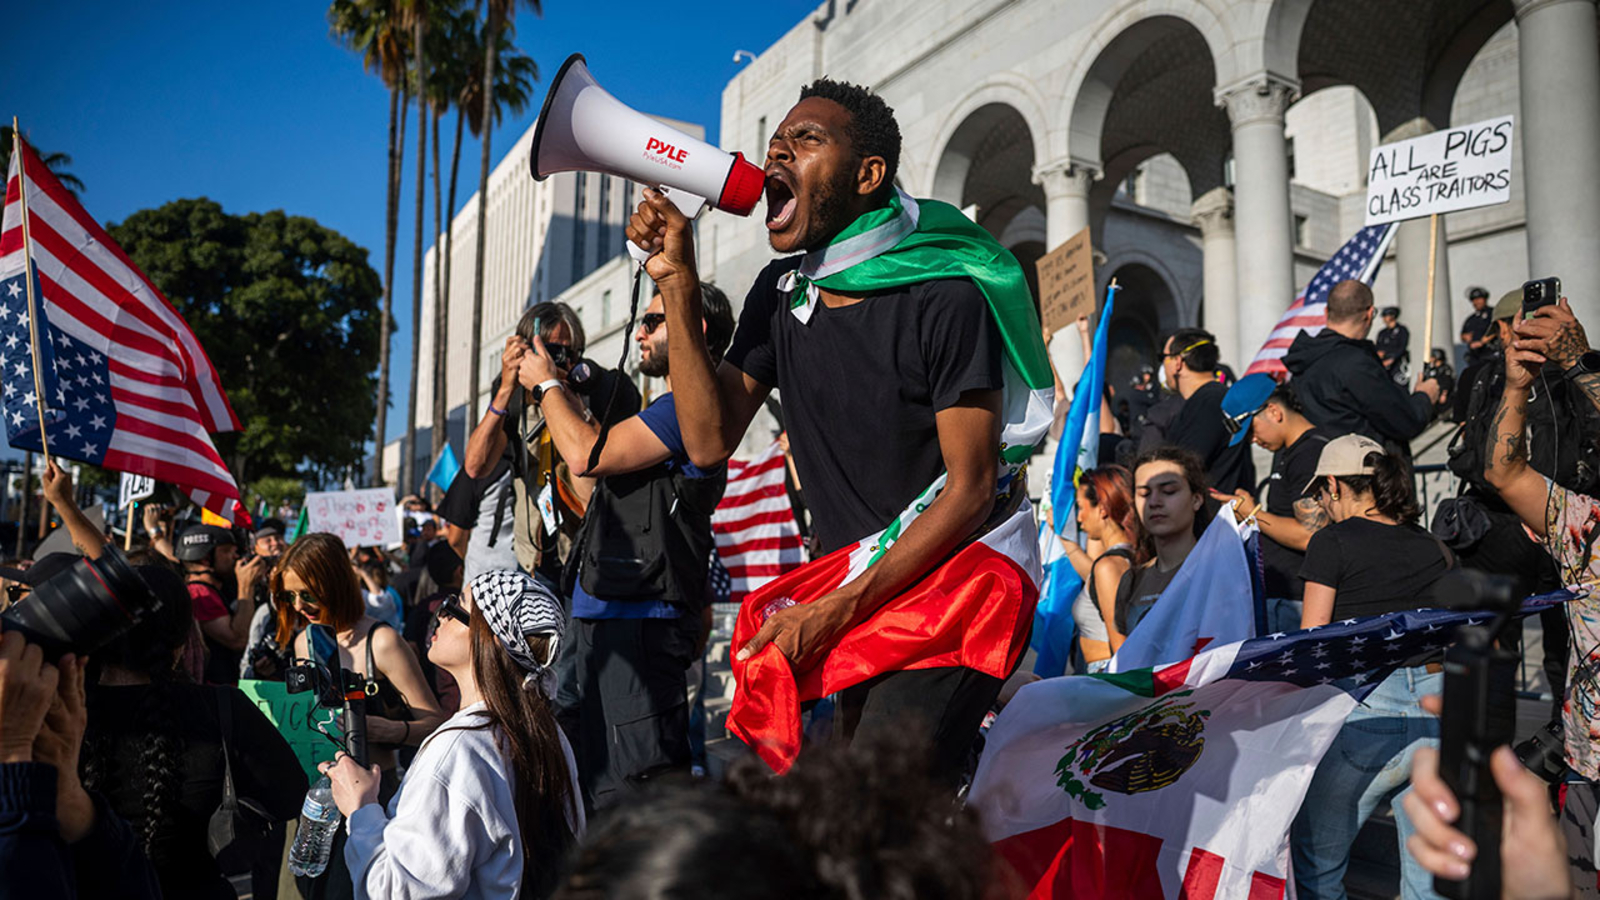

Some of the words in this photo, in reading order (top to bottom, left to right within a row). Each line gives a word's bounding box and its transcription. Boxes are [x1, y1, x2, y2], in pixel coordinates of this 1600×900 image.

[1371, 146, 1427, 182] ALL
[1444, 121, 1512, 160] PIGS
[1416, 161, 1458, 183] ARE
[1369, 186, 1421, 216] CLASS
[1426, 169, 1510, 203] TRAITORS
[183, 533, 209, 546] PRESS
